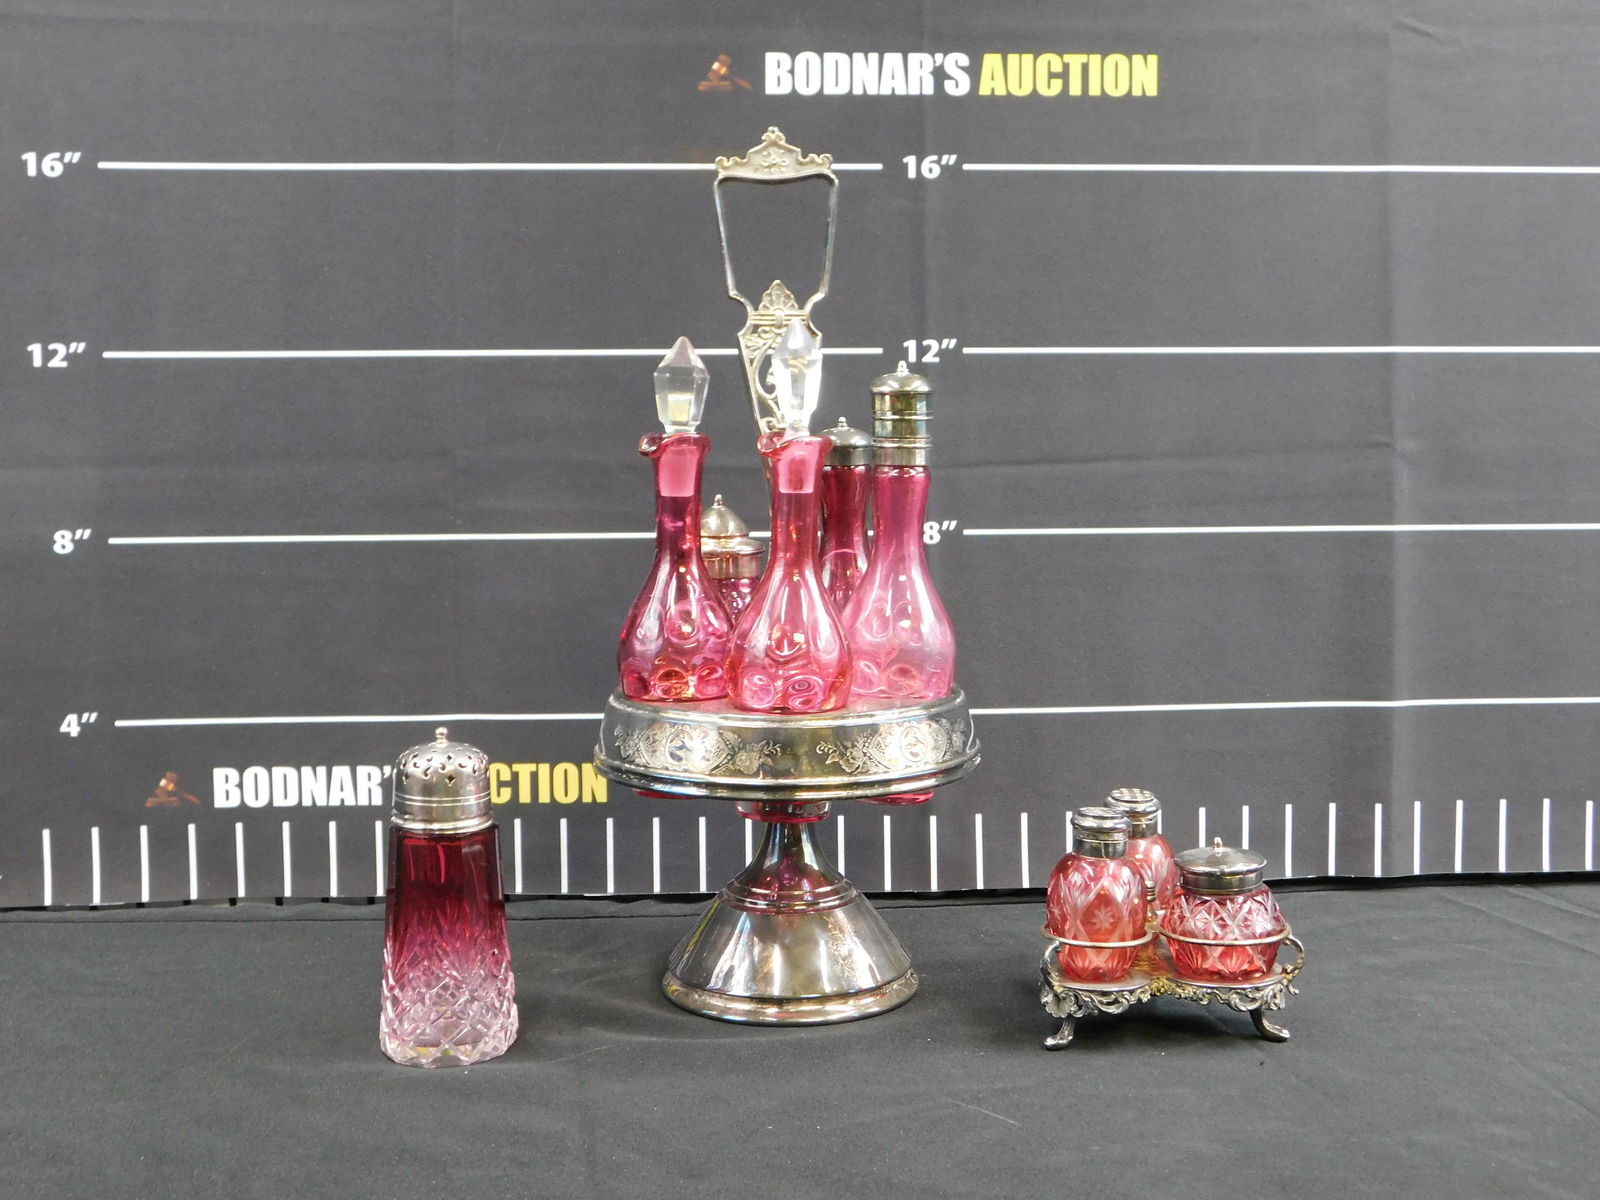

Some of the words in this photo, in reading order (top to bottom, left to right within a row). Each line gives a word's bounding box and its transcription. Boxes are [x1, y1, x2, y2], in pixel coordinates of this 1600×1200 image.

[765, 51, 971, 97] BODNAR'S
[978, 52, 1159, 98] AUCTION
[21, 151, 82, 179] 16"
[902, 154, 958, 180] 16"
[26, 341, 87, 368] 12"
[902, 338, 958, 364] 12"
[52, 527, 92, 555] 8"
[922, 520, 958, 545] 8"
[59, 711, 98, 738] 4"
[212, 765, 393, 808] BODNAR'
[489, 761, 608, 805] CTION
